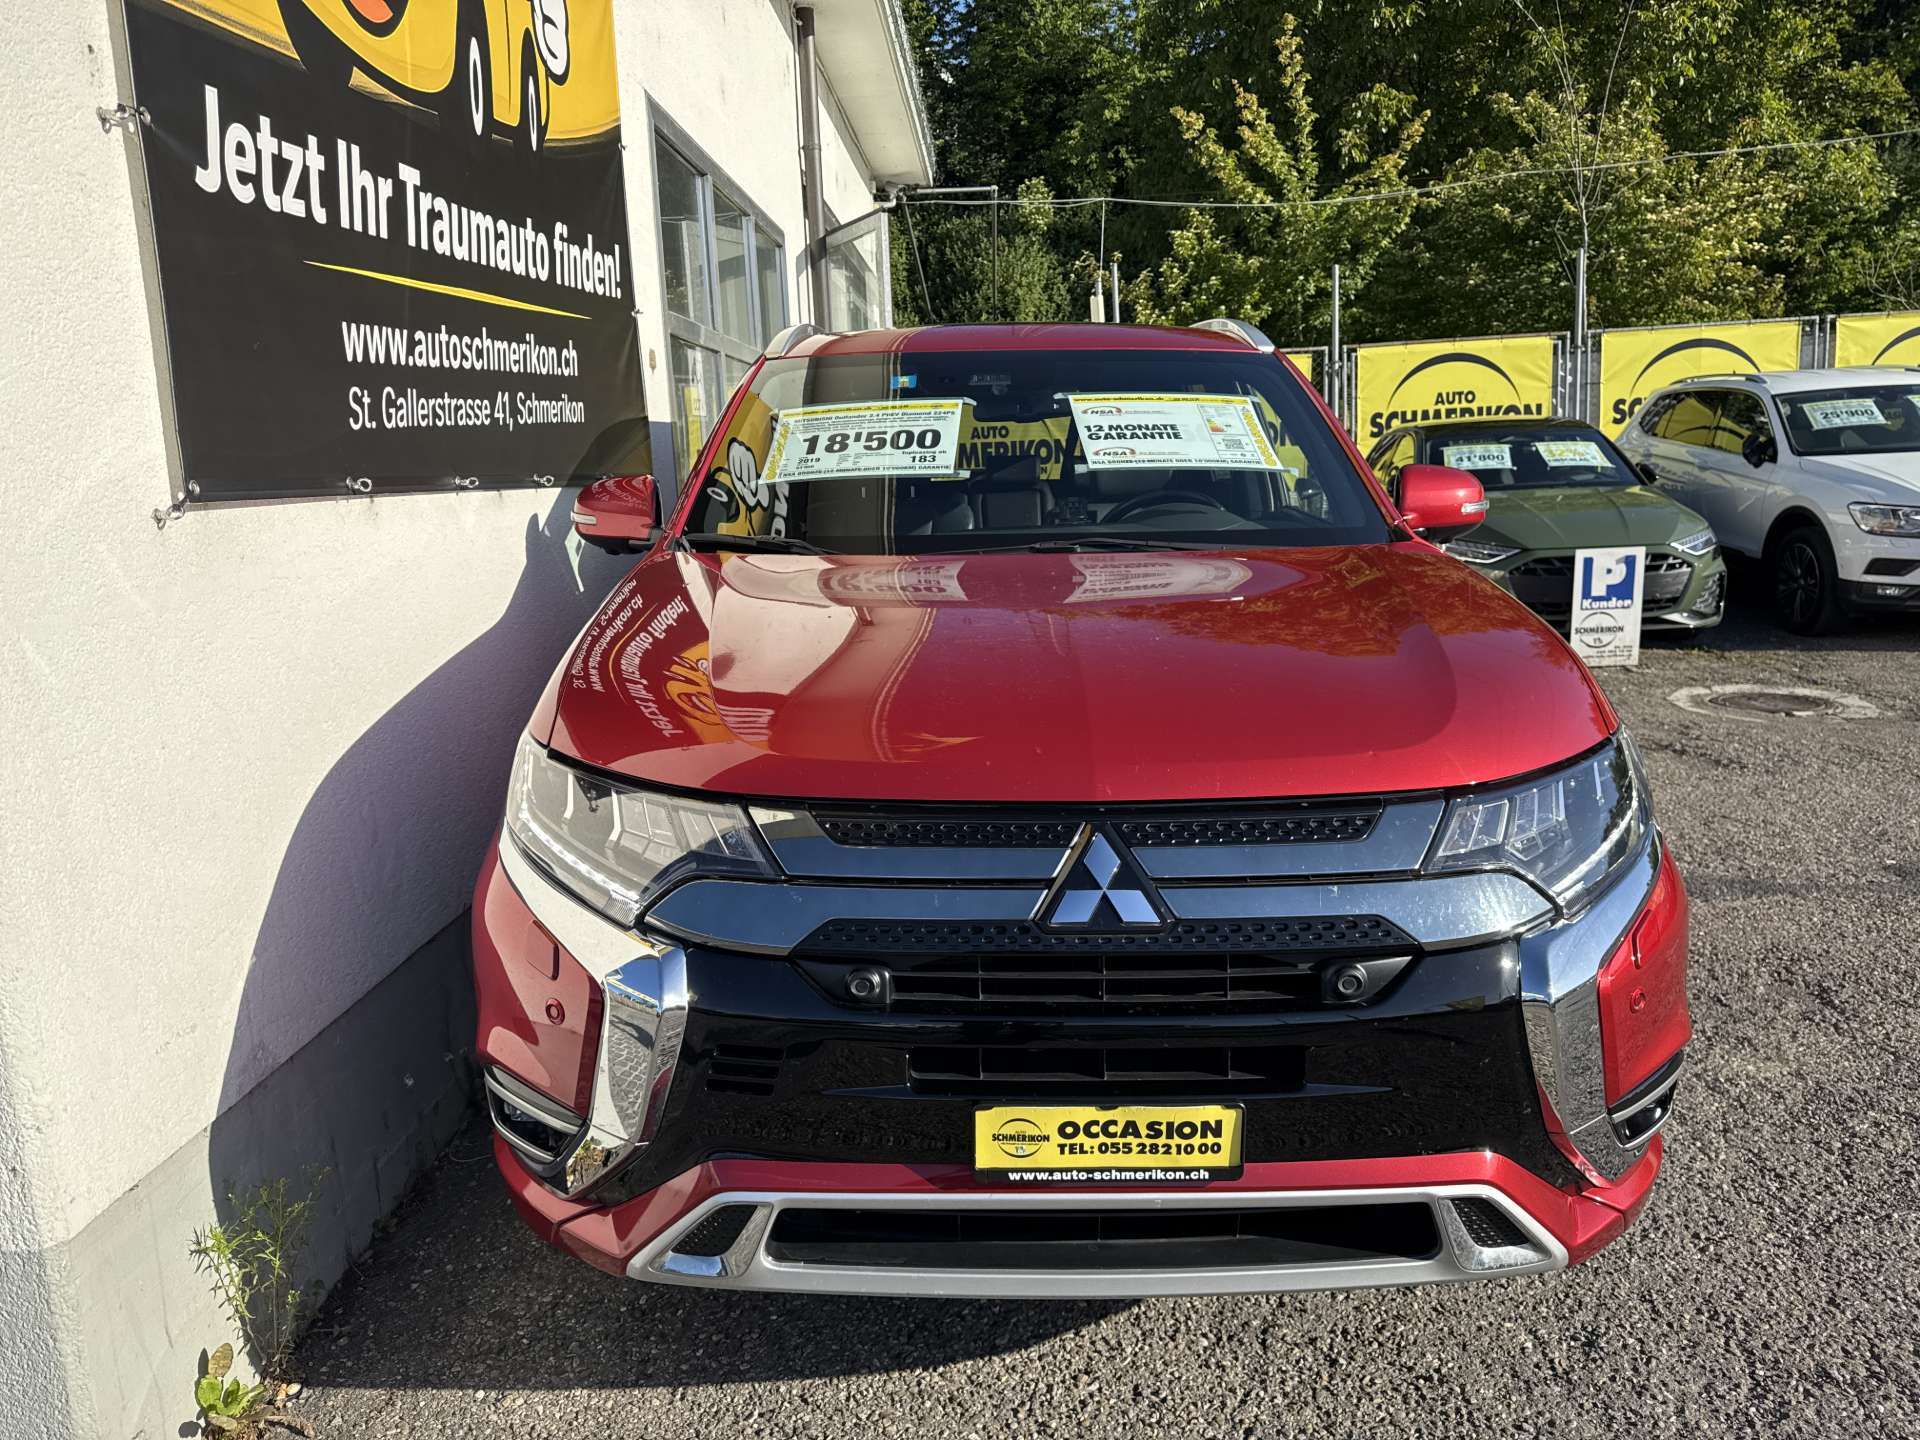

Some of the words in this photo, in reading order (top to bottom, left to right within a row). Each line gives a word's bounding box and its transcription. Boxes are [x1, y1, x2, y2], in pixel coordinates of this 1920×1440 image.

[195, 84, 326, 224] Jetzt
[337, 138, 392, 239] Ihr
[398, 162, 549, 282] Traumauto
[553, 221, 622, 299] finden!
[341, 321, 578, 376] www.autoschmerikon.ch
[1434, 391, 1476, 406] AUTO
[349, 386, 376, 430] St.
[382, 386, 490, 429] Gallerstrasse
[494, 391, 513, 431] 41,
[517, 391, 584, 424] Schmerikon
[971, 425, 1009, 440] AUTO
[1108, 424, 1179, 432] MONATE
[803, 428, 942, 455] 18'500
[1087, 432, 1183, 440] GARANTIE
[910, 455, 937, 463] 183
[1455, 453, 1505, 462] 41'800
[1582, 597, 1633, 610] Kunden
[1057, 1119, 1223, 1140] OCCASION
[991, 1132, 1051, 1143] SCHMERIKON
[1057, 1143, 1095, 1155] TEL:
[1098, 1142, 1133, 1154] 055
[1008, 1168, 1210, 1182] www.auto-schmerikon.ch
